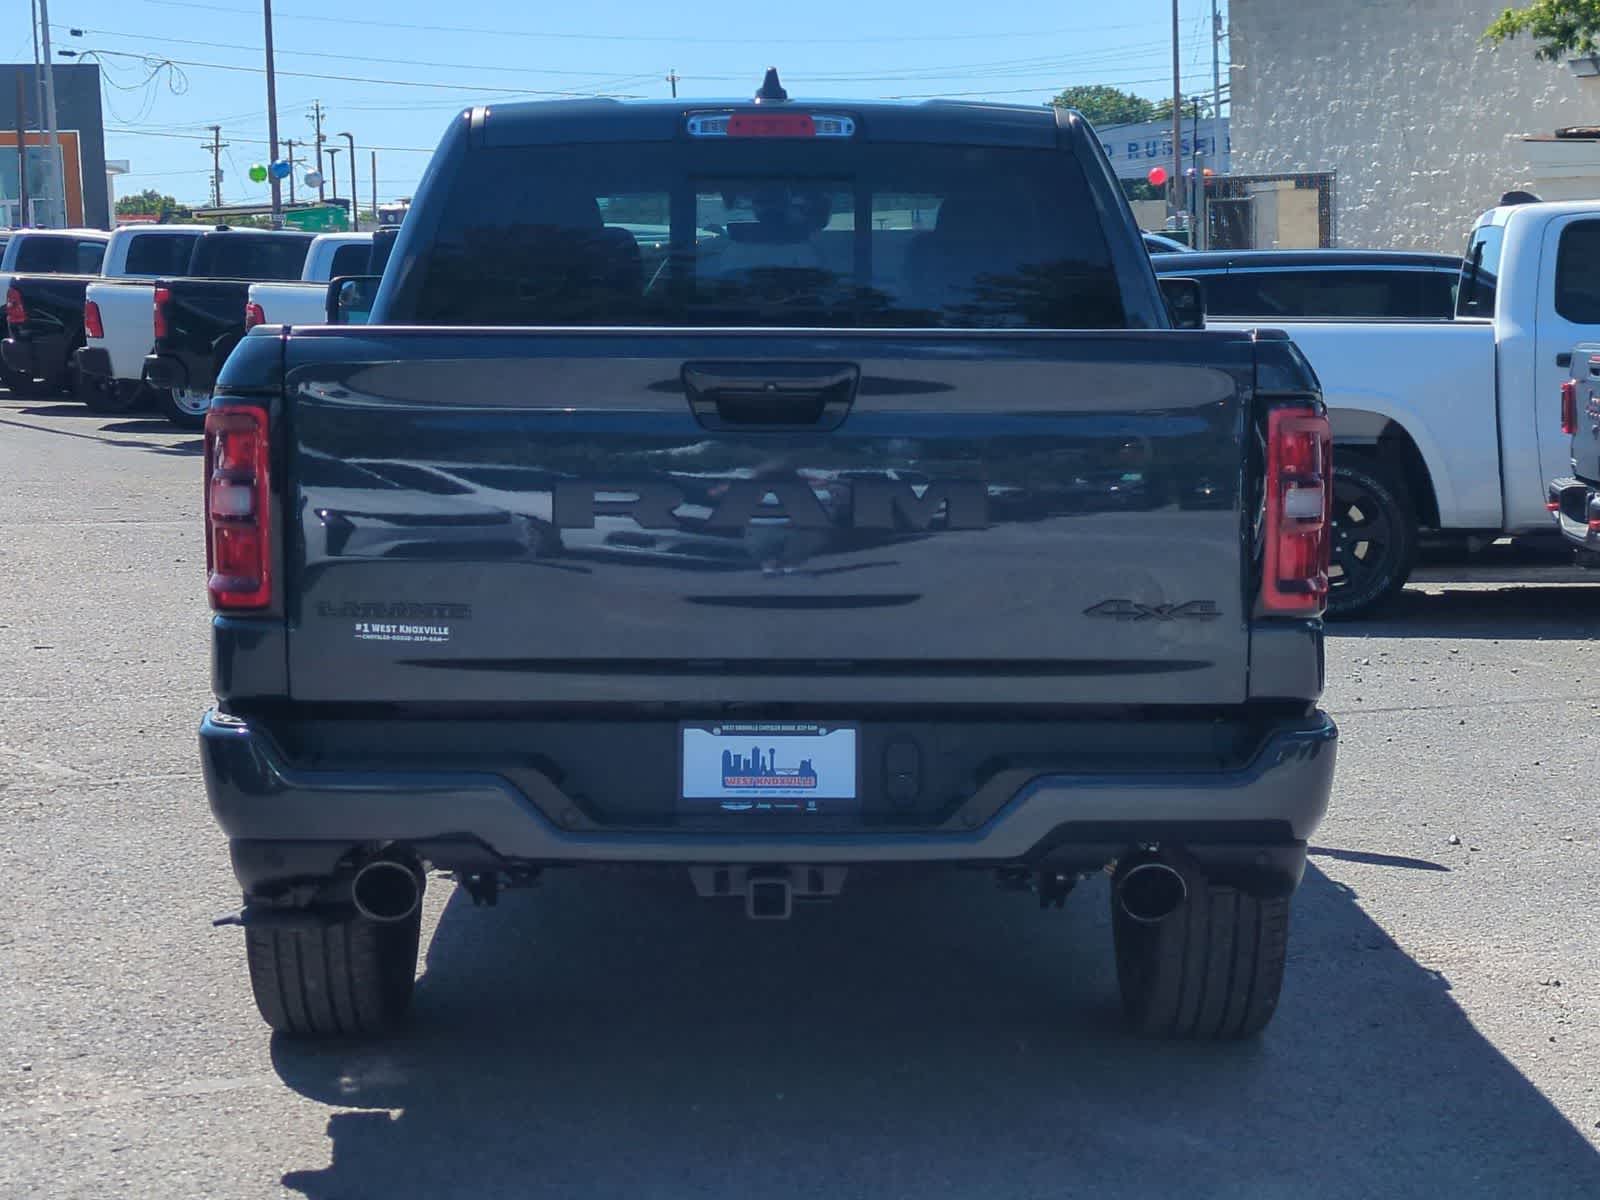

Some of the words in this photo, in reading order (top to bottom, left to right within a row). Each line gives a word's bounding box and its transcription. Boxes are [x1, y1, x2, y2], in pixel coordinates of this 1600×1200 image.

[554, 478, 988, 529] RAM
[372, 623, 397, 634] WEST
[399, 624, 449, 635] KNOXVILLE
[725, 776, 753, 786] WEST
